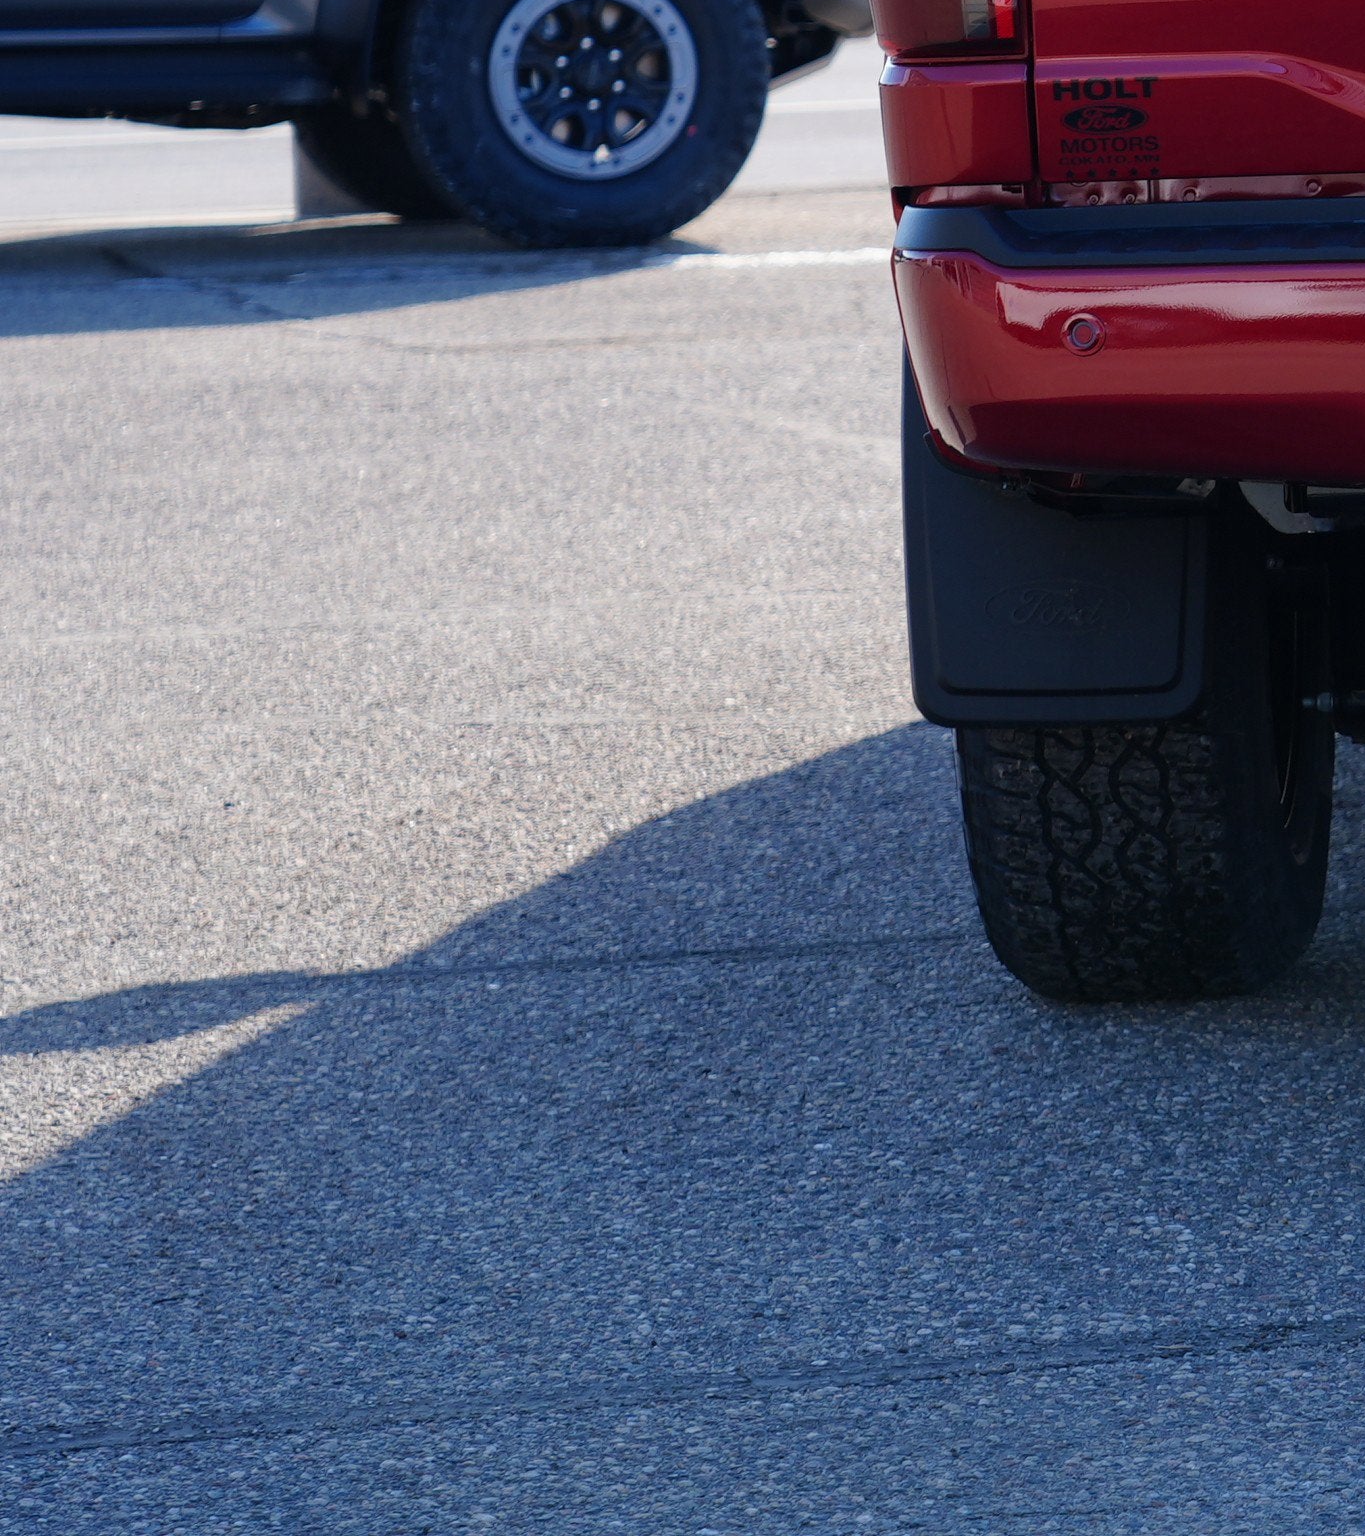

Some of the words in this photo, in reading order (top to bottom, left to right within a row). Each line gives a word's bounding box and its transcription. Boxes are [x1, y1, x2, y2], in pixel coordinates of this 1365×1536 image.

[1053, 76, 1158, 101] HOLT
[1077, 107, 1133, 130] Ford
[1060, 136, 1160, 154] MOTORS
